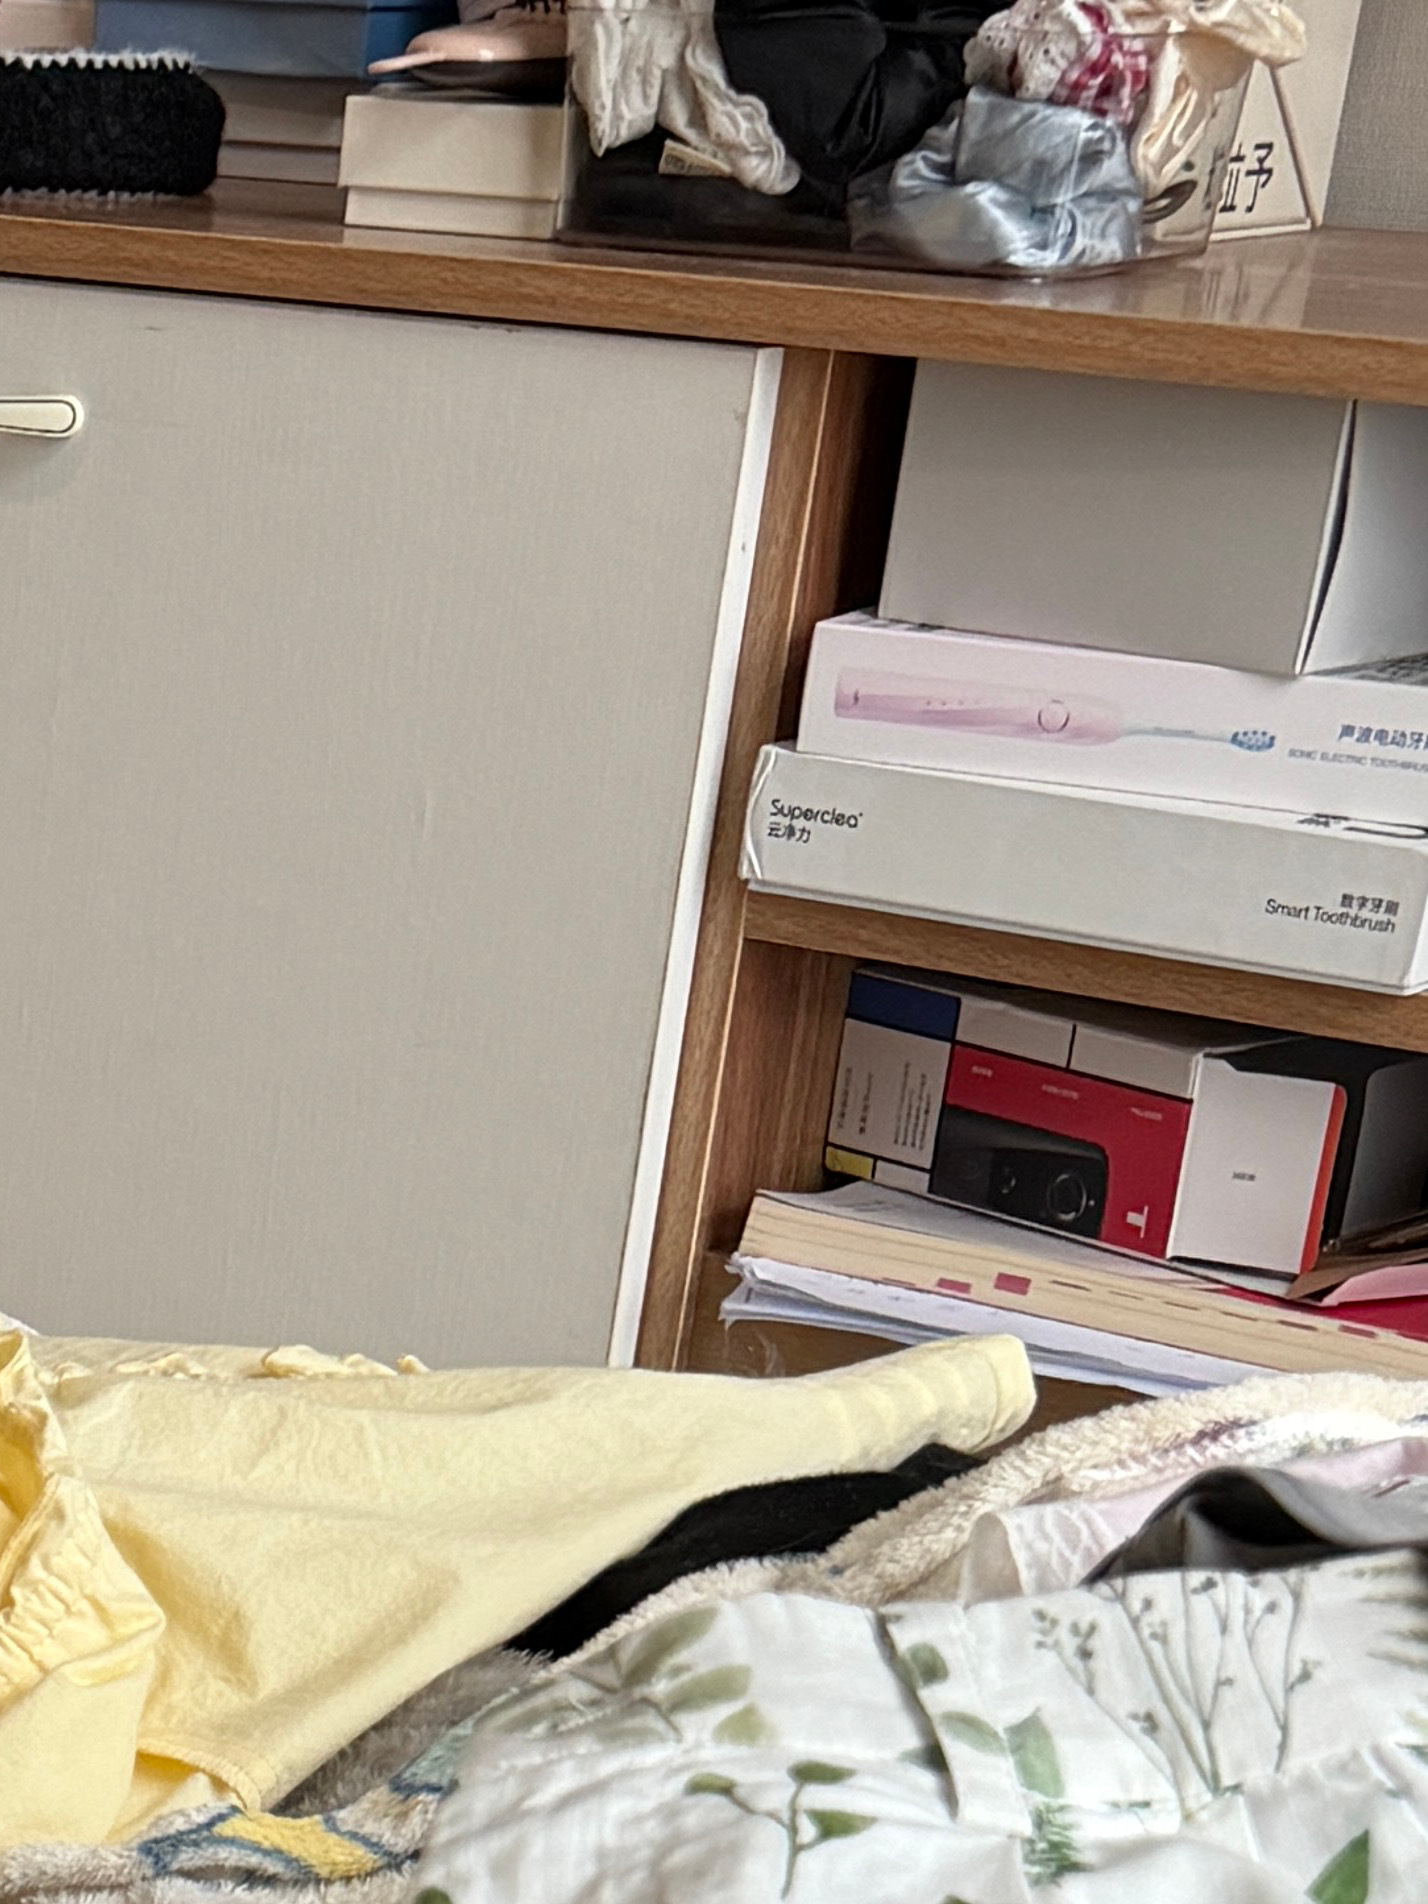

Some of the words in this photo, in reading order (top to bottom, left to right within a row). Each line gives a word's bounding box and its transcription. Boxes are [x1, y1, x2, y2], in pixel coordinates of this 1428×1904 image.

[1336, 722, 1428, 750] 声波电动牙
[1264, 897, 1310, 921] Smart
[1312, 905, 1396, 933] Toothbrush
